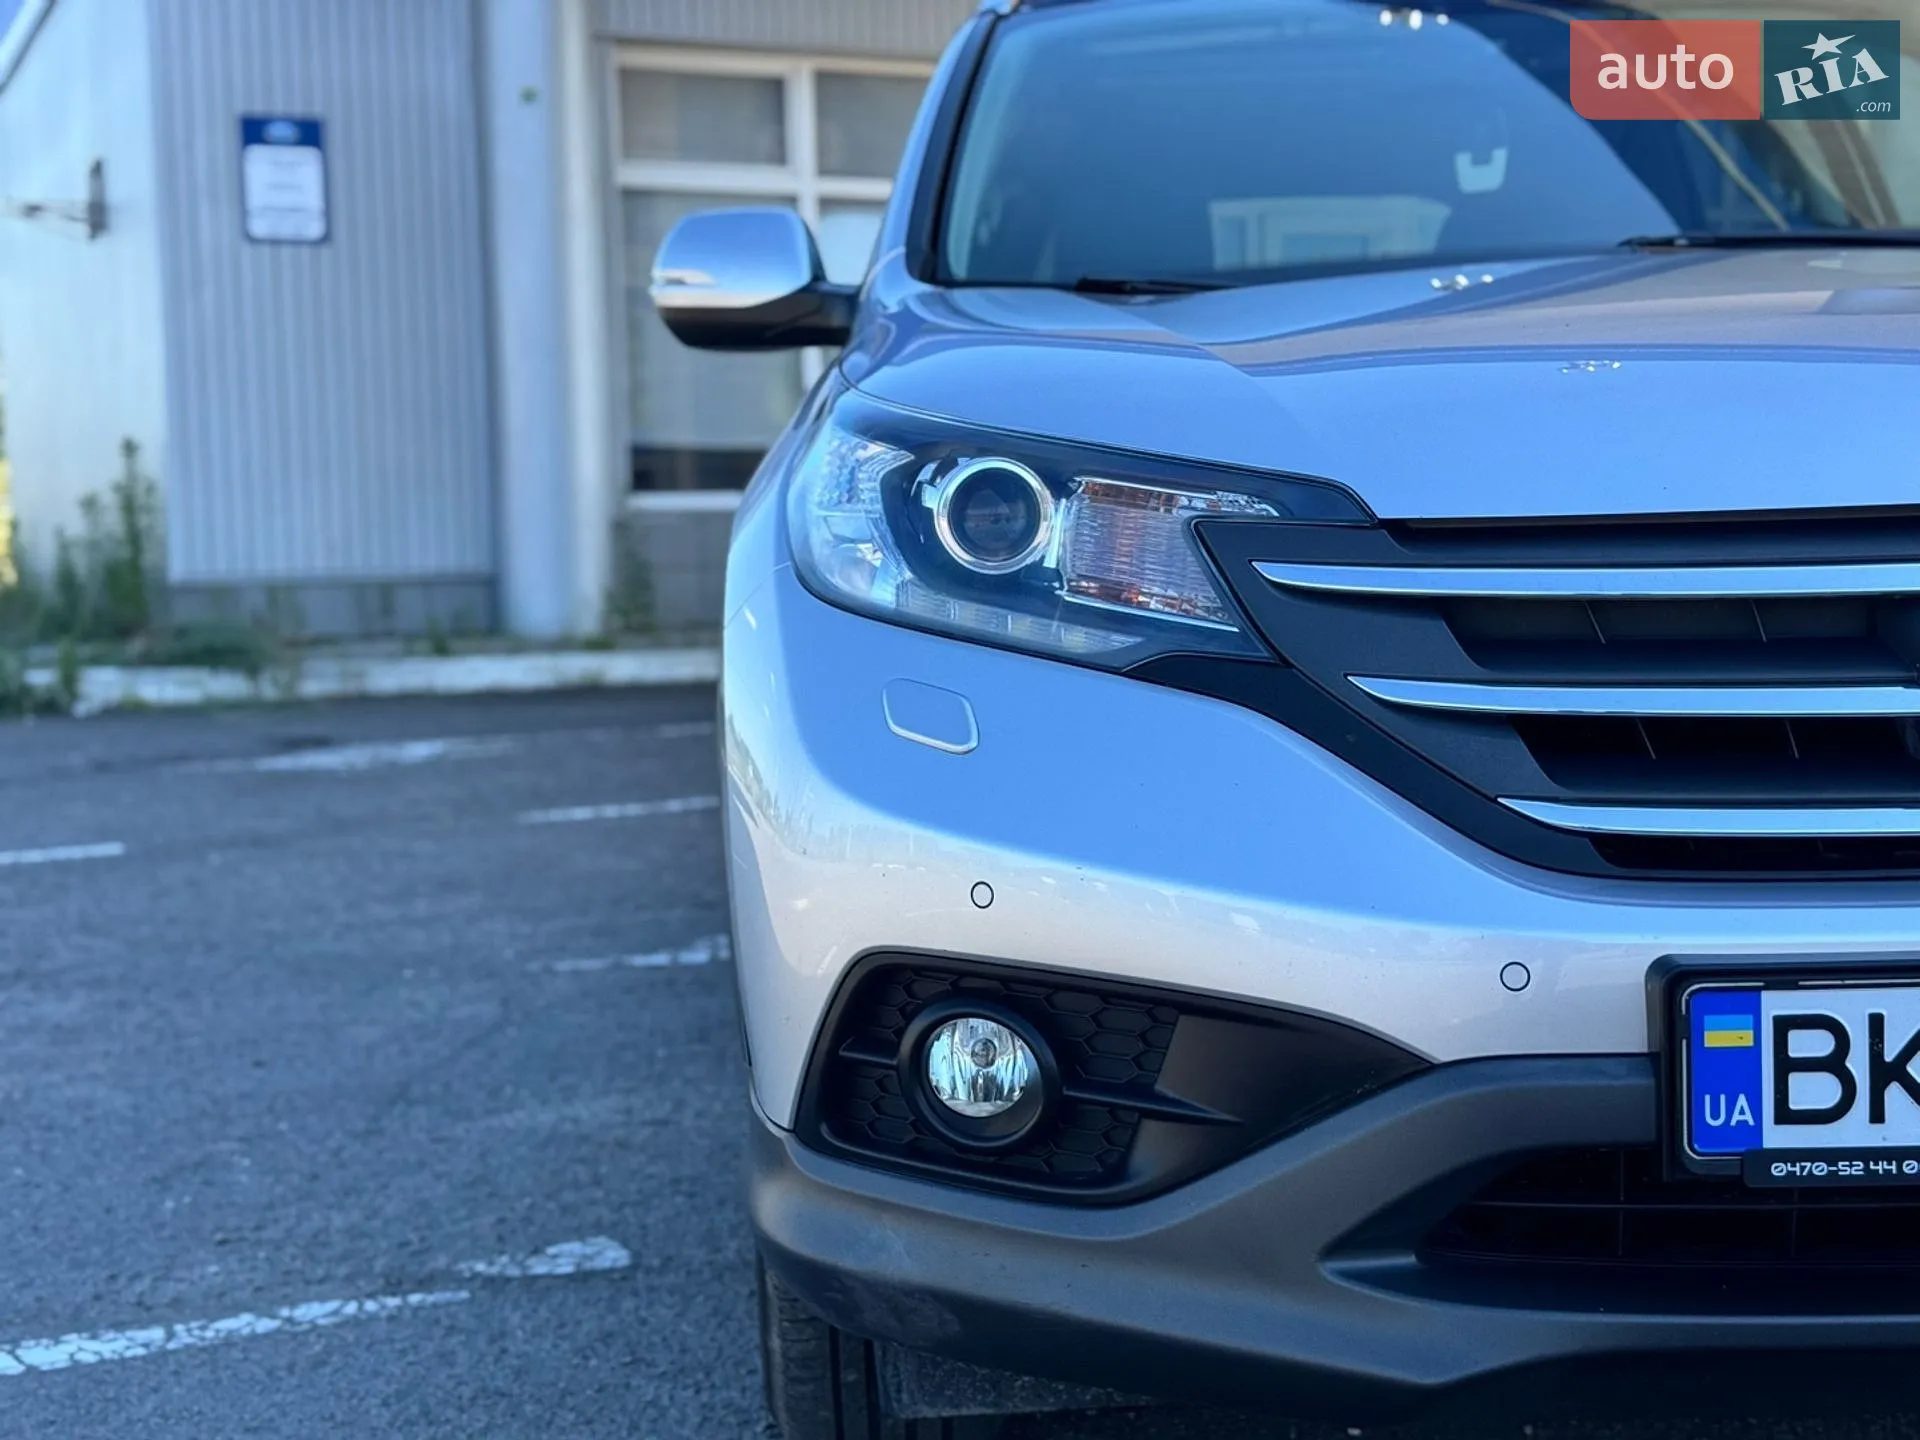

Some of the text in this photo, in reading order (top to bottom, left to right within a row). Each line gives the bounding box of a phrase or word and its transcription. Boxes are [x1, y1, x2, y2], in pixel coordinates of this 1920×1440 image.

[1772, 1012, 1920, 1125] BK
[1704, 1093, 1755, 1127] UA
[1771, 1160, 1920, 1176] 0470-52 44 0
